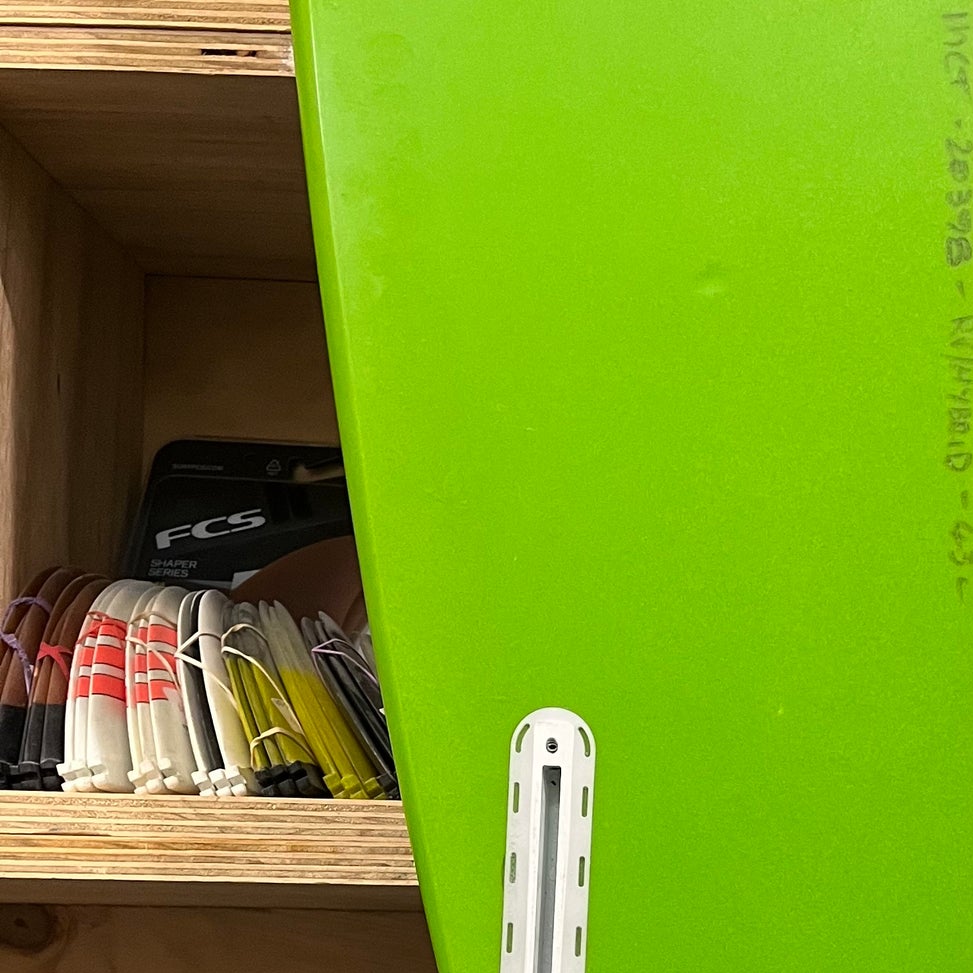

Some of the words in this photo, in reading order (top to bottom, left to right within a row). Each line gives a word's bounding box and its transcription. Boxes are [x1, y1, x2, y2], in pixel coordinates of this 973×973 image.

[155, 508, 266, 550] FCS
[150, 559, 198, 569] SHAPER
[148, 567, 189, 578] SERIES
